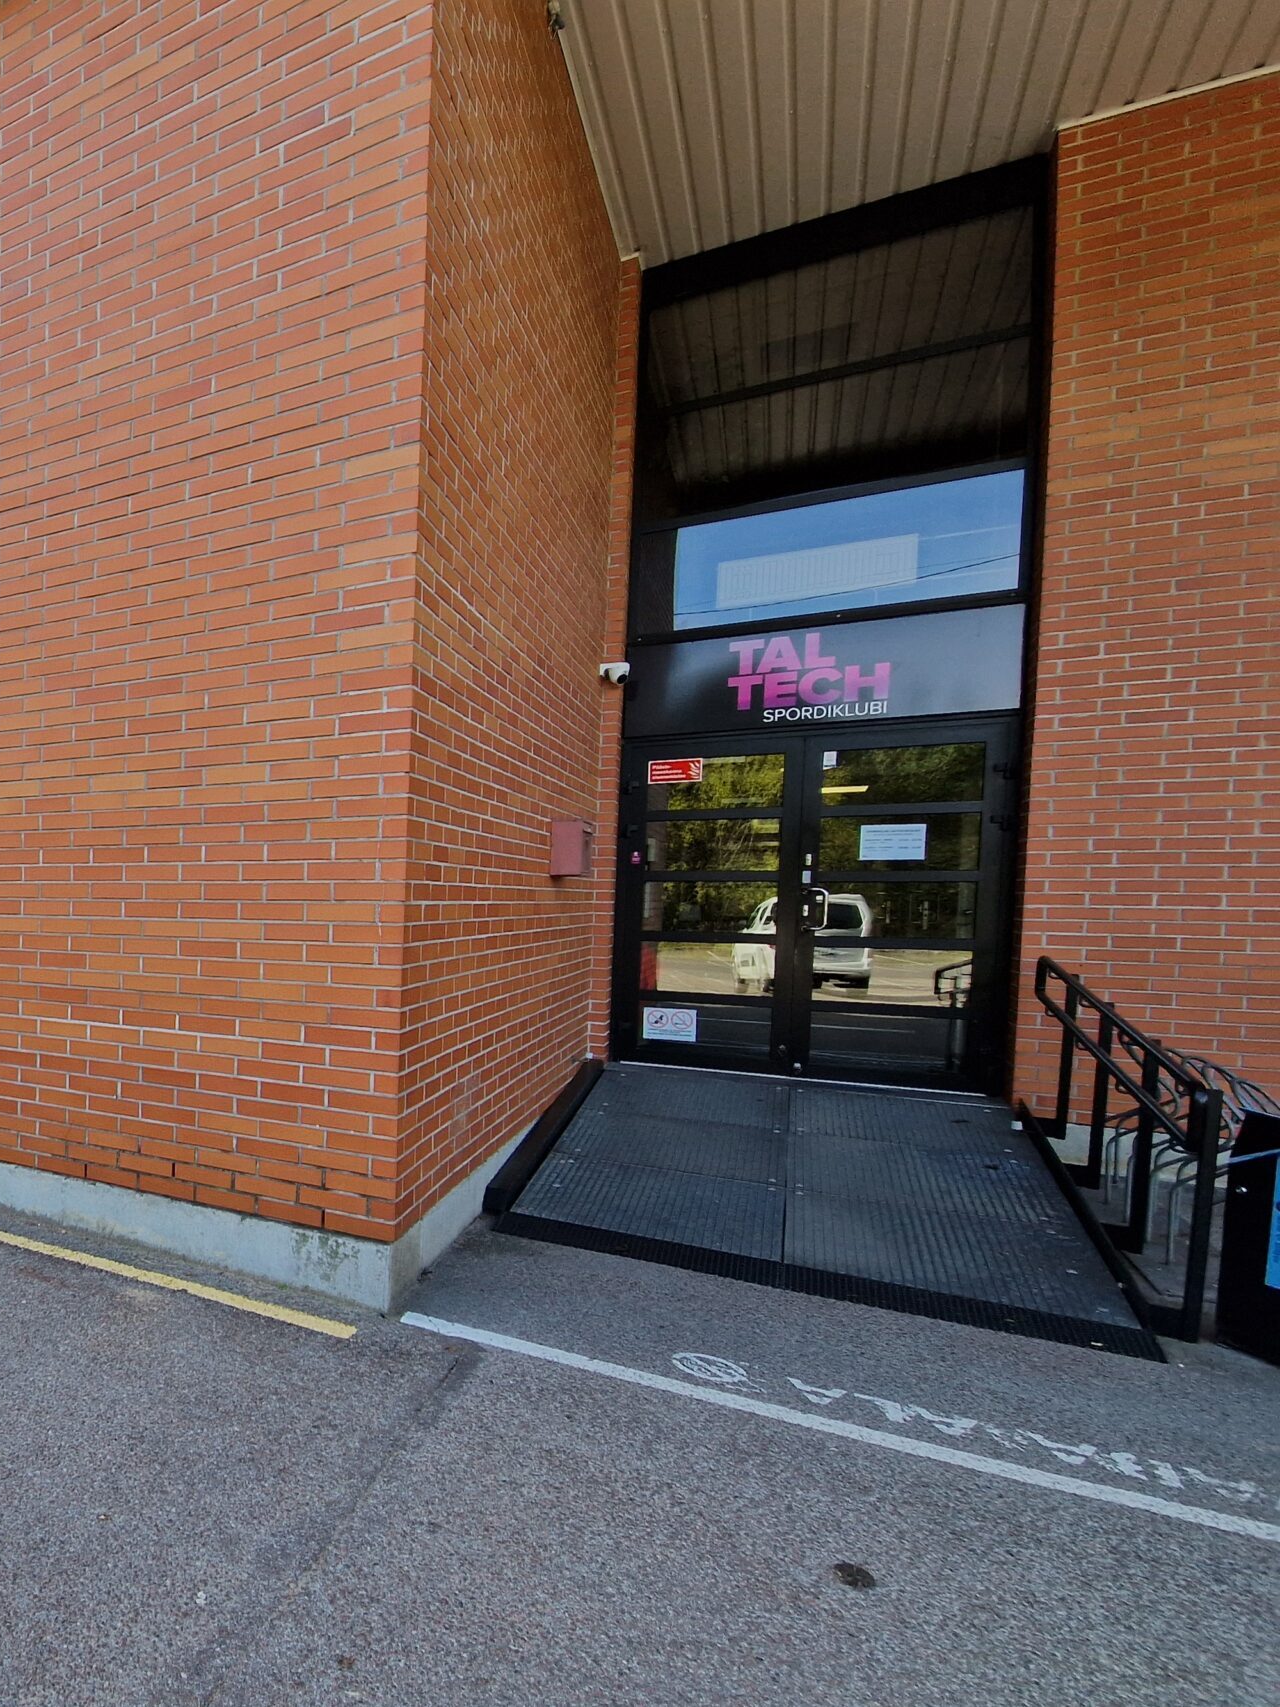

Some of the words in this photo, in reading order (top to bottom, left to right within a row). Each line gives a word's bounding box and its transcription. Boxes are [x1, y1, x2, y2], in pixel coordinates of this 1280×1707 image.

[729, 632, 836, 676] TAL
[727, 662, 891, 711] TECH
[762, 700, 888, 723] SPORDIKLUBI
